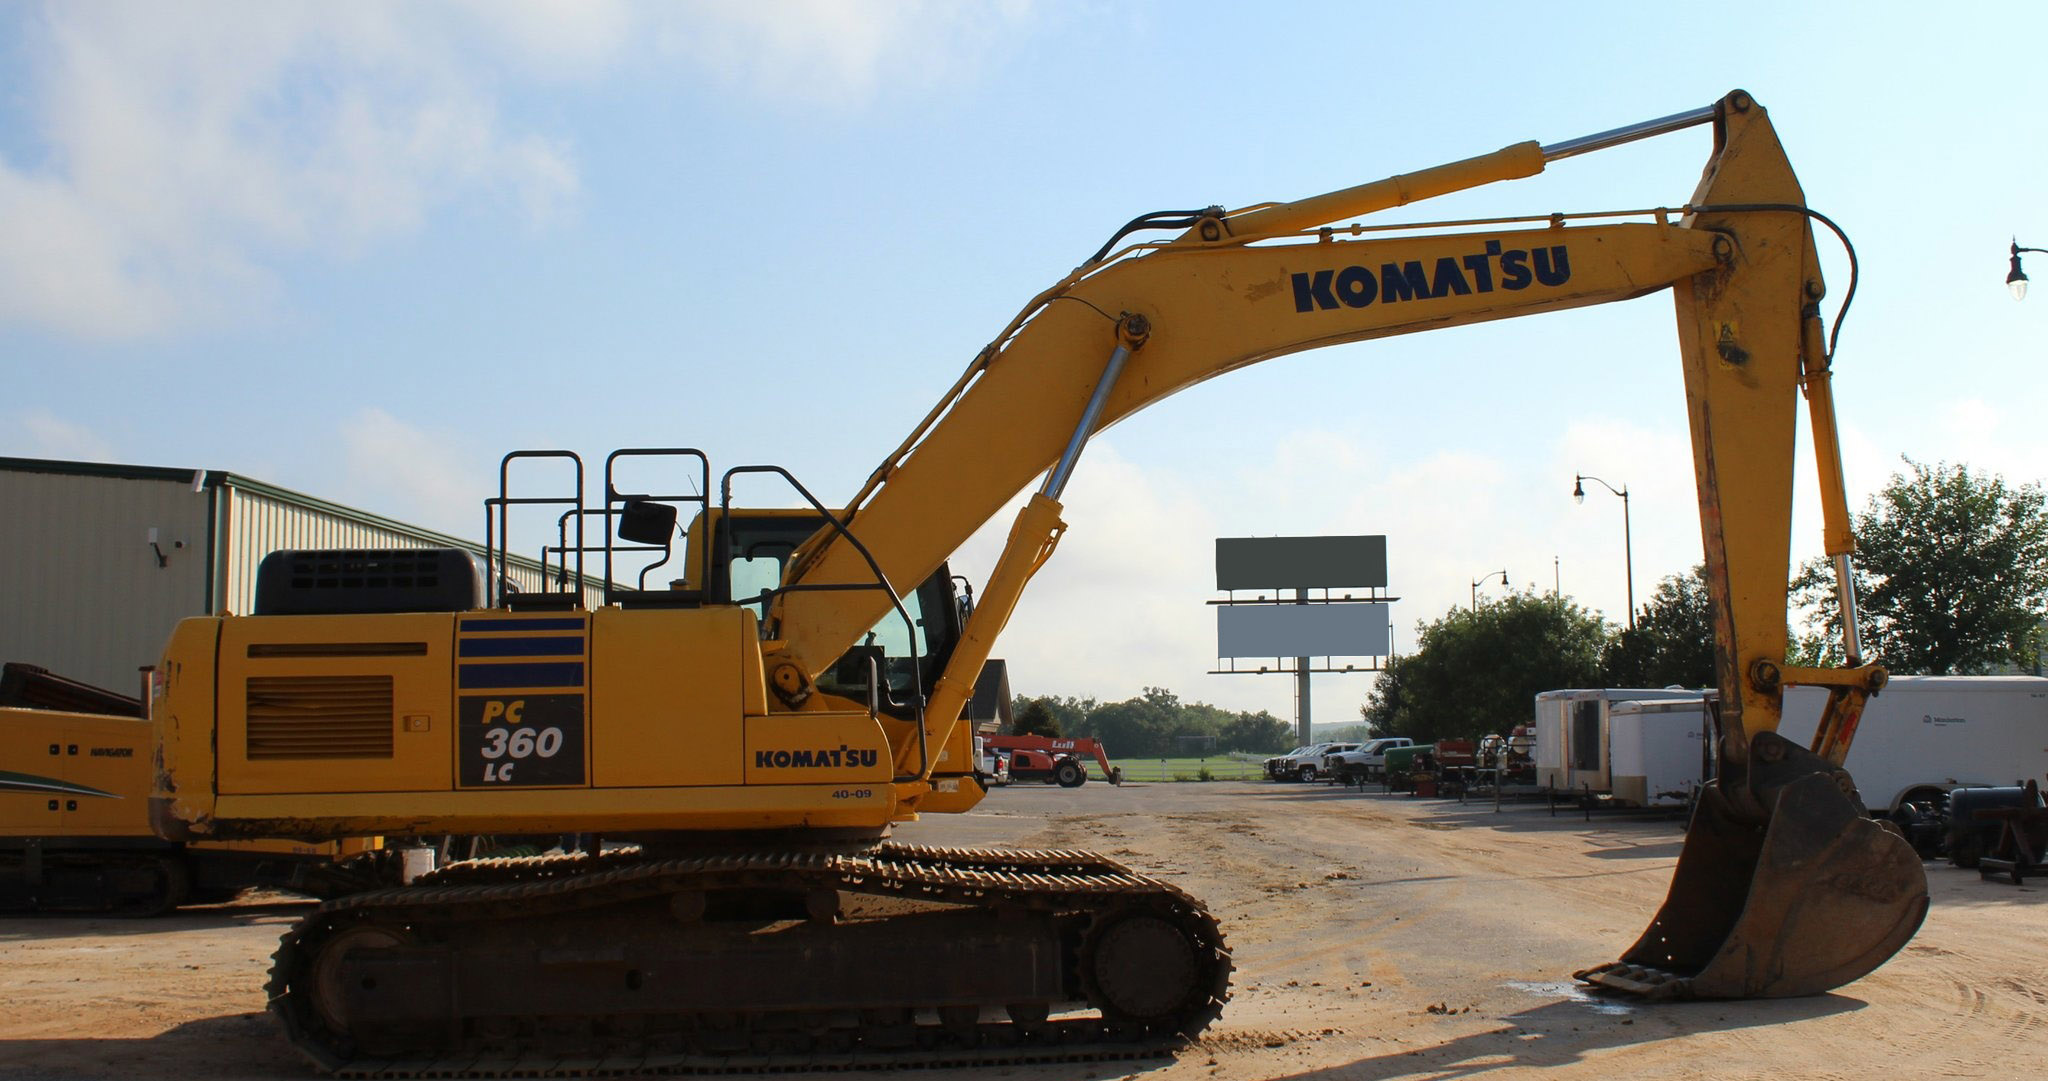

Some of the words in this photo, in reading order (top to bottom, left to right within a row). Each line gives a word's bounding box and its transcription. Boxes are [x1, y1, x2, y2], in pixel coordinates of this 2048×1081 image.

[1291, 240, 1571, 313] KOMATSU
[482, 700, 525, 724] PC
[481, 727, 563, 759] 360
[755, 745, 877, 768] KOMATSU
[483, 763, 514, 781] LC
[832, 789, 872, 799] 40-09
